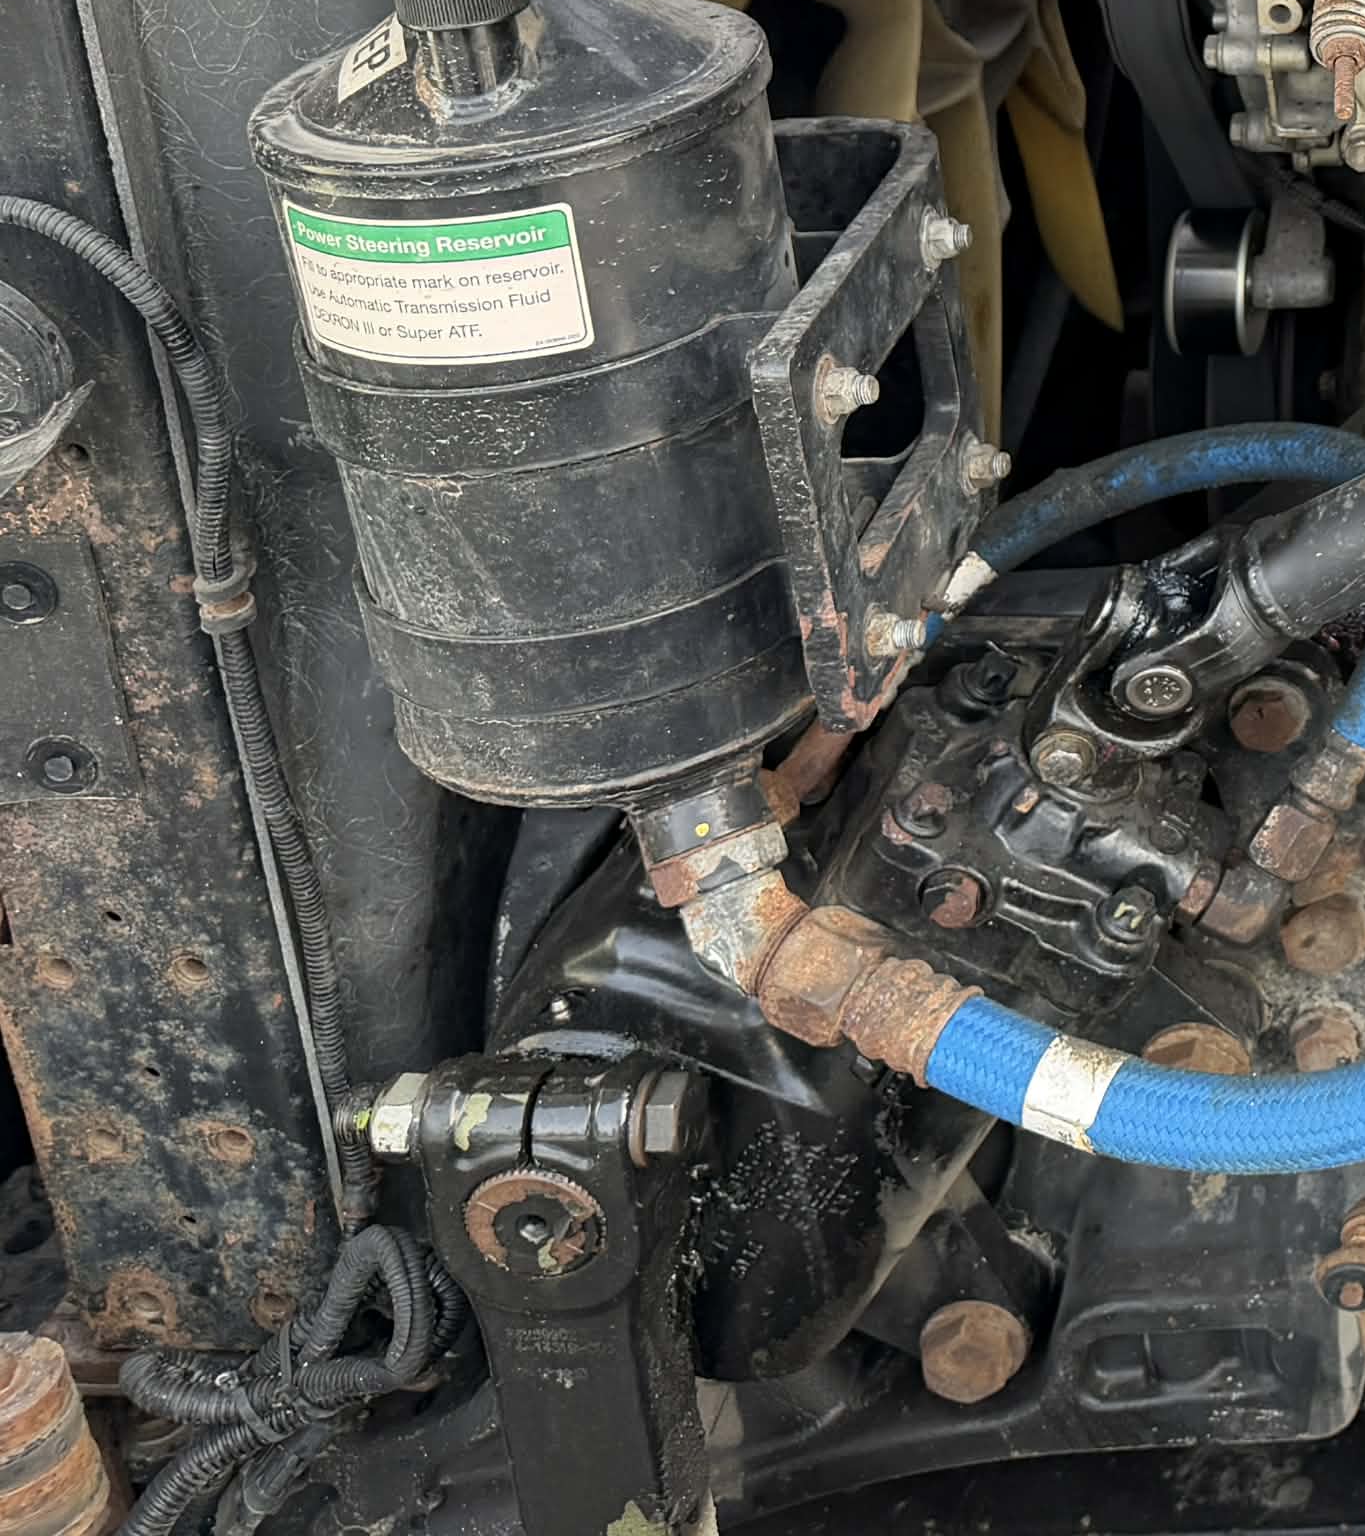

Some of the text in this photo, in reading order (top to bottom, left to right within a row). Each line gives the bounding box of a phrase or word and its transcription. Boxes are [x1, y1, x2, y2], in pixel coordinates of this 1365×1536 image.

[296, 220, 547, 258] Power Steering Reservoir
[330, 268, 408, 289] appropriate
[411, 273, 455, 290] mark
[458, 274, 480, 288] on
[485, 261, 565, 284] reservoir.
[328, 290, 393, 313] Automatic
[394, 297, 504, 315] Transmission
[508, 289, 551, 310] Fluid
[363, 321, 375, 336] III
[379, 326, 393, 338] or
[396, 324, 443, 342] Super
[448, 322, 483, 340] ATF.
